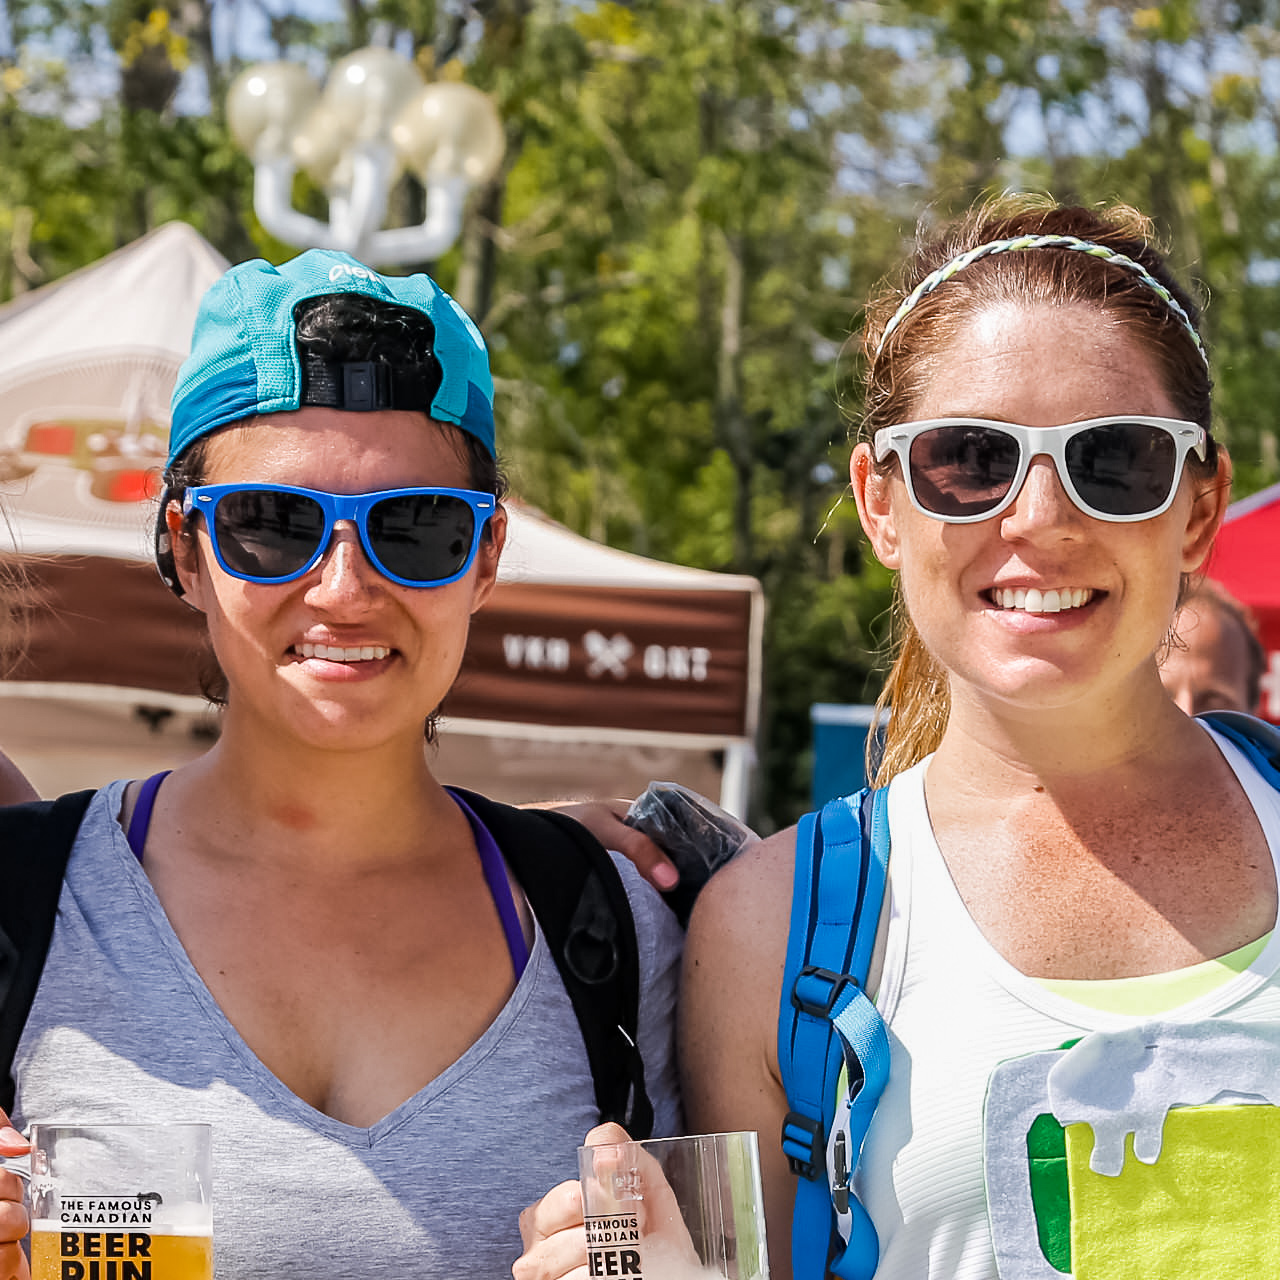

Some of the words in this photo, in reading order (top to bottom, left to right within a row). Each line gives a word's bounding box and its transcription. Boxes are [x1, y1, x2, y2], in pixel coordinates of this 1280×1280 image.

[328, 262, 383, 284] ciel
[60, 1200, 86, 1211] THE
[88, 1200, 152, 1211] FAMOUS
[60, 1212, 152, 1224] CANADIAN
[592, 1218, 638, 1231] FAMOUS
[60, 1231, 152, 1257] BEER
